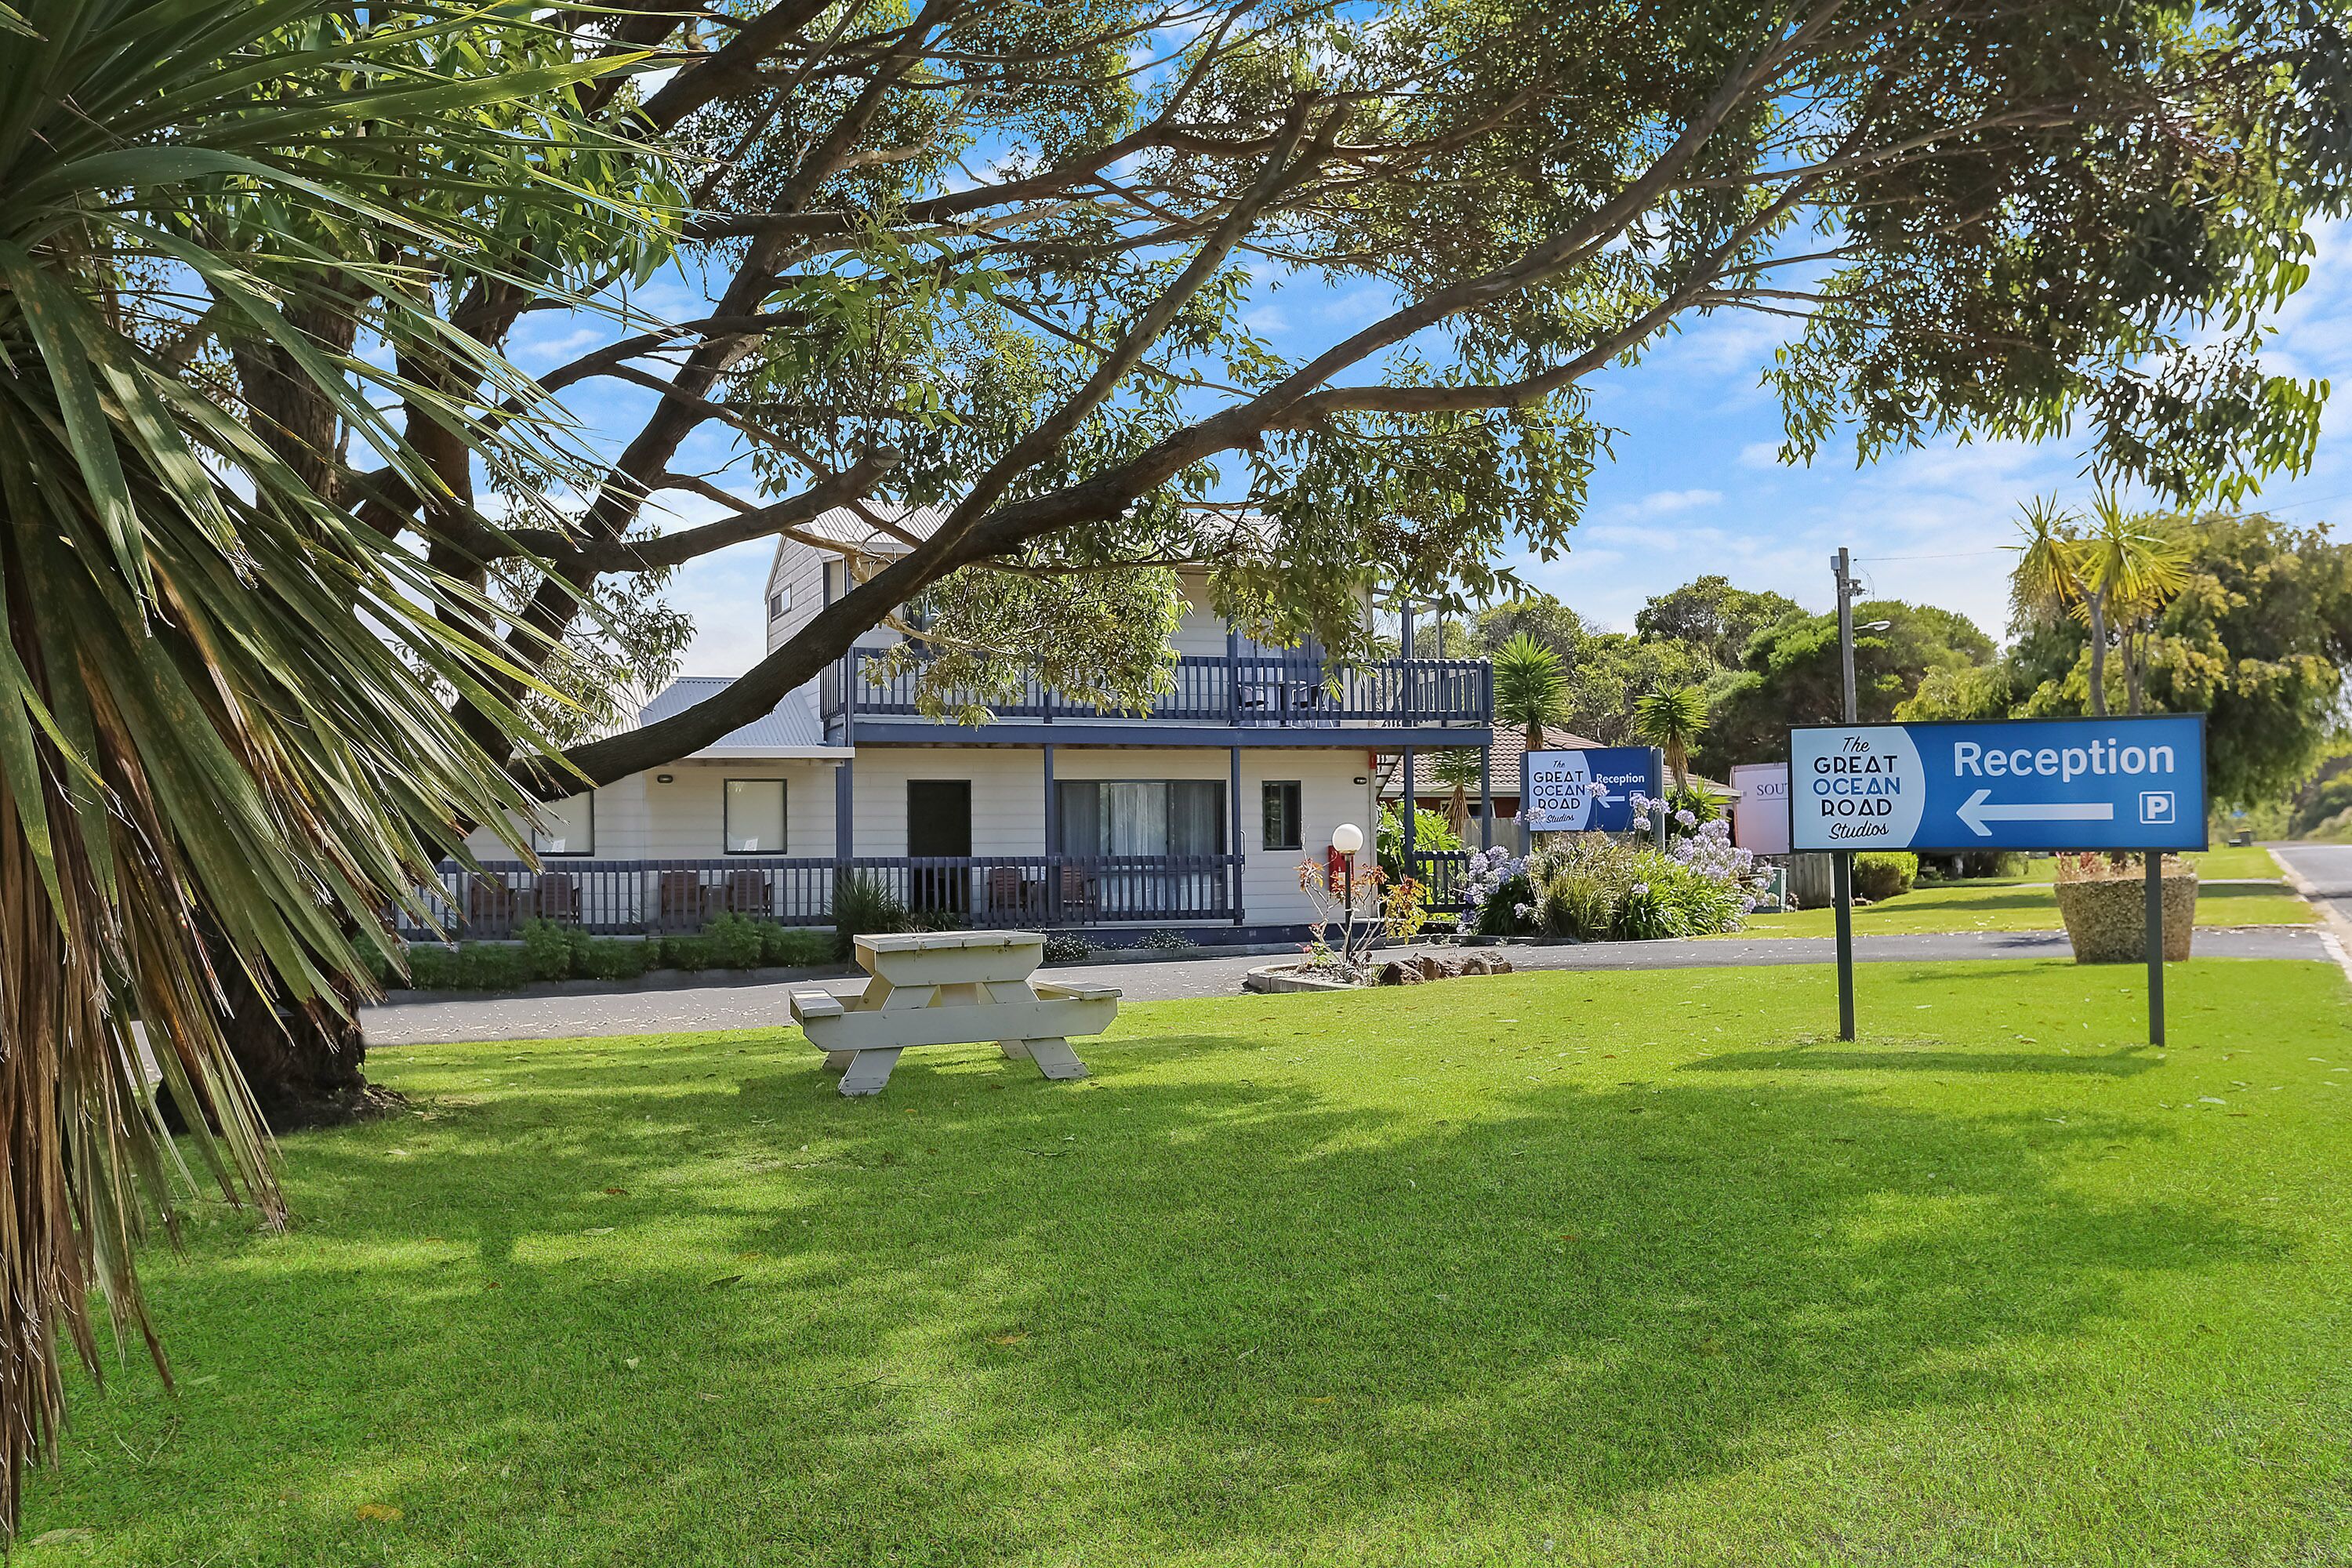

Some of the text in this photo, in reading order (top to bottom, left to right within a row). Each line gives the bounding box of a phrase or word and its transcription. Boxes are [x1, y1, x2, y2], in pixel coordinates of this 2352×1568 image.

[1842, 735, 1870, 753] The
[1553, 760, 1566, 768] The
[1813, 755, 1898, 775] GREAT
[1955, 738, 2175, 782] Reception
[1534, 771, 1584, 783] GREAT
[1596, 772, 1645, 786] Reception
[1533, 785, 1585, 797] OCEAN
[1757, 782, 1788, 797] SOU
[1813, 777, 1900, 796] OCEAN
[1537, 797, 1581, 810] ROAD
[1821, 798, 1893, 817] ROAD
[2147, 795, 2169, 820] P
[1545, 813, 1575, 824] Studios
[1828, 820, 1889, 840] Studios
